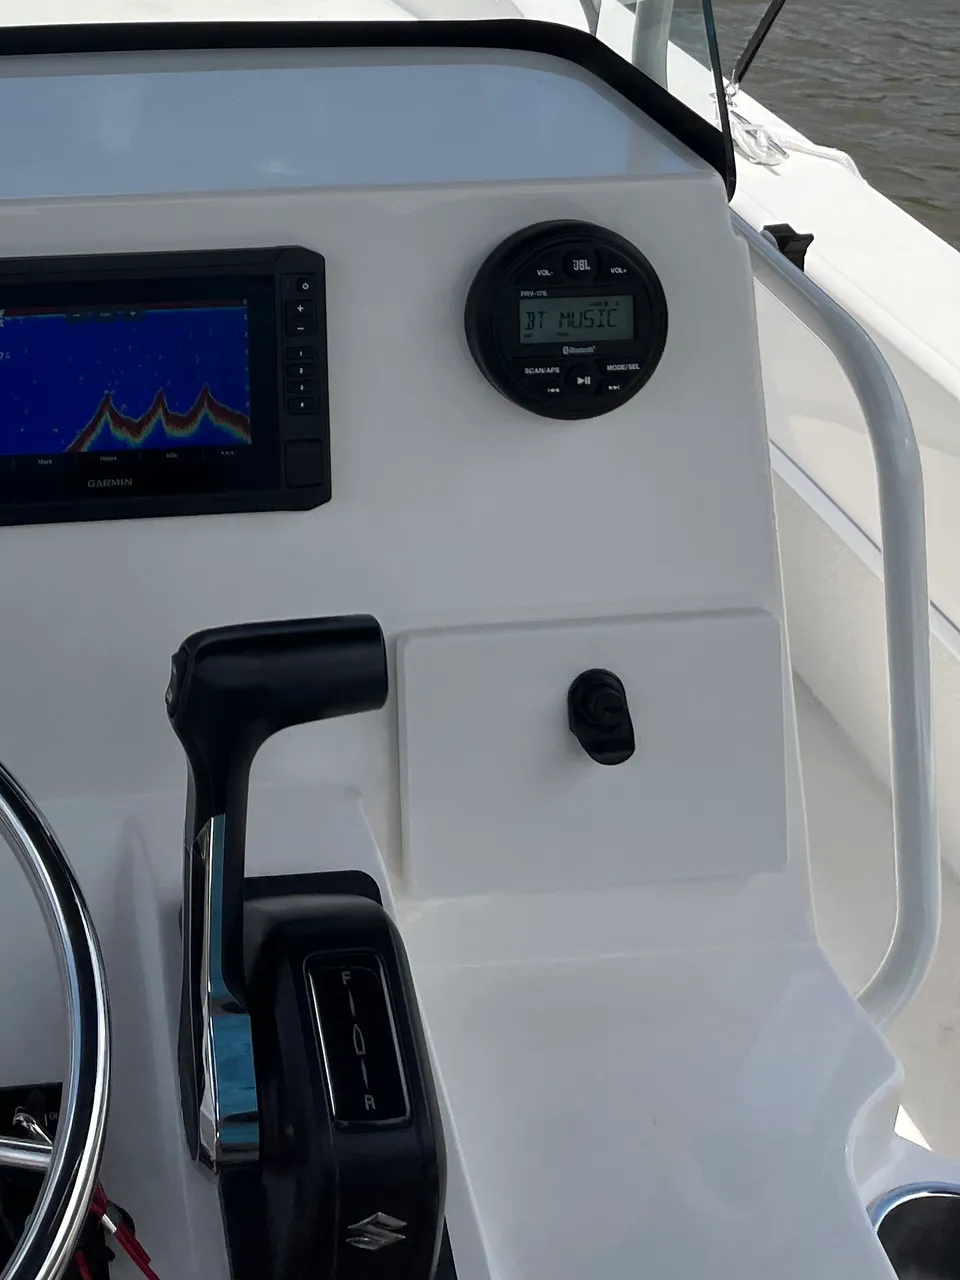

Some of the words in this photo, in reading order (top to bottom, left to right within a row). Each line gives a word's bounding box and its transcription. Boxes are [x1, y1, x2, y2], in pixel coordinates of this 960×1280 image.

[572, 259, 591, 271] JBL
[524, 311, 546, 330] BT
[558, 308, 619, 329] MUSIC
[87, 477, 133, 488] GARMIN
[341, 970, 351, 985] F
[364, 1094, 376, 1111] R
